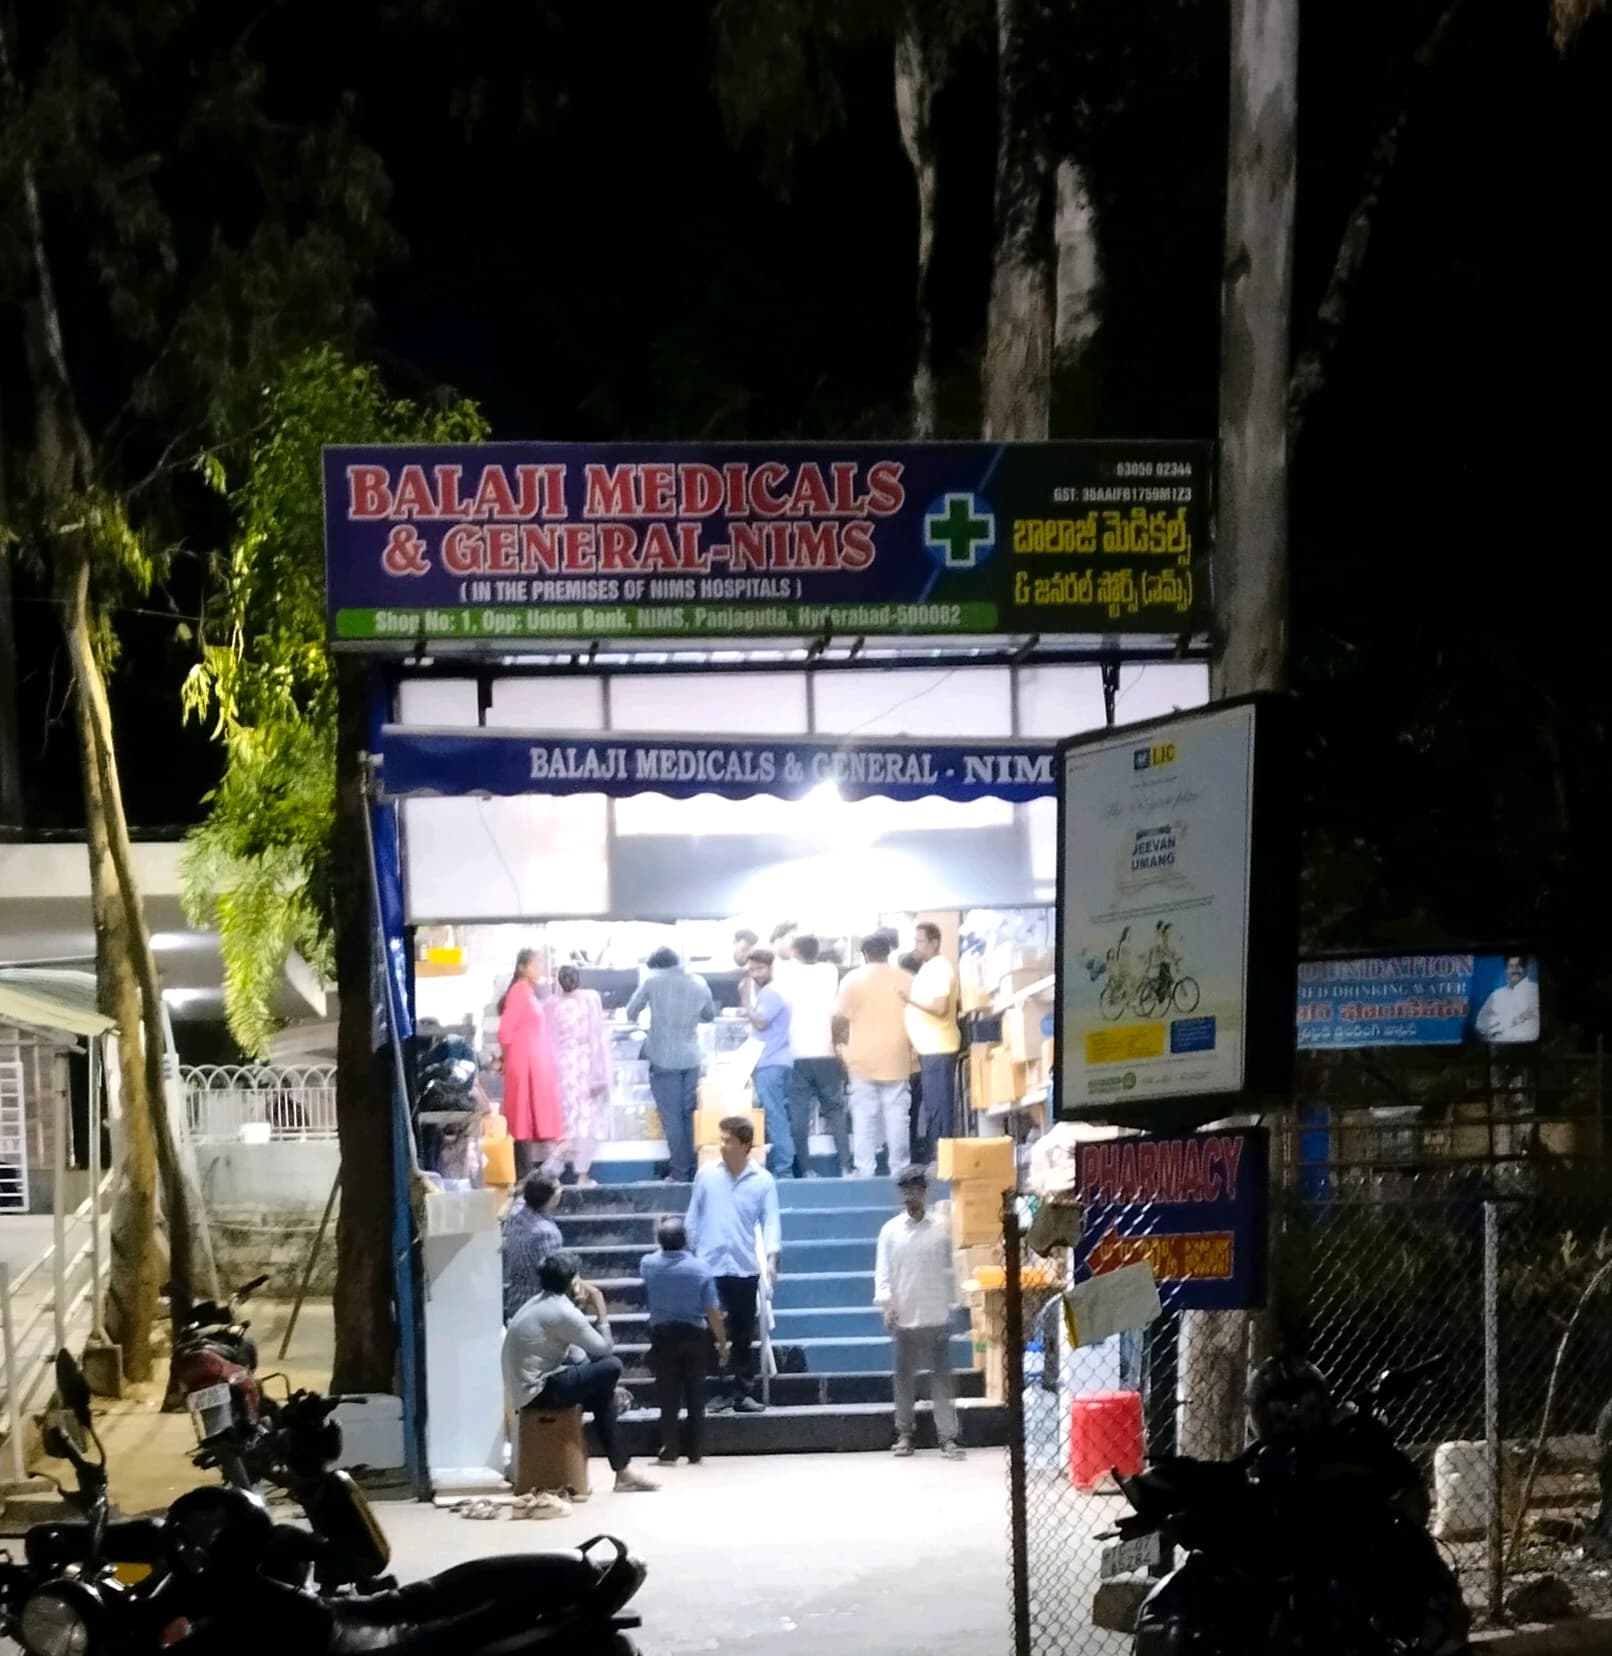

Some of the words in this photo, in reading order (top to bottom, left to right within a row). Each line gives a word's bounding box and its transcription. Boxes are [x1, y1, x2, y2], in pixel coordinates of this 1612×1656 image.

[347, 464, 567, 520] BALAJI
[584, 460, 905, 518] MEDICALS
[381, 524, 431, 577] &
[441, 520, 876, 575] GENERAL-NIMS
[496, 581, 528, 601] THE
[531, 580, 618, 600] PREMISES
[624, 580, 645, 599] OF
[651, 579, 696, 599] NIMS
[375, 609, 419, 634] Shop
[425, 609, 457, 632] No:
[482, 609, 522, 634] Opp:
[527, 608, 578, 630] Union
[584, 607, 632, 632] Bank,
[638, 607, 689, 631] NIMS,
[530, 747, 627, 780] BALAJI
[635, 748, 775, 782] MEDICALS
[783, 753, 804, 783] &
[812, 752, 937, 784] GENERAL
[1152, 744, 1177, 765] LIC
[1132, 835, 1176, 856] JEEVAN
[1131, 853, 1176, 871] UMANG
[1413, 981, 1467, 996] WATER
[1081, 1137, 1244, 1204] PHARMACY
